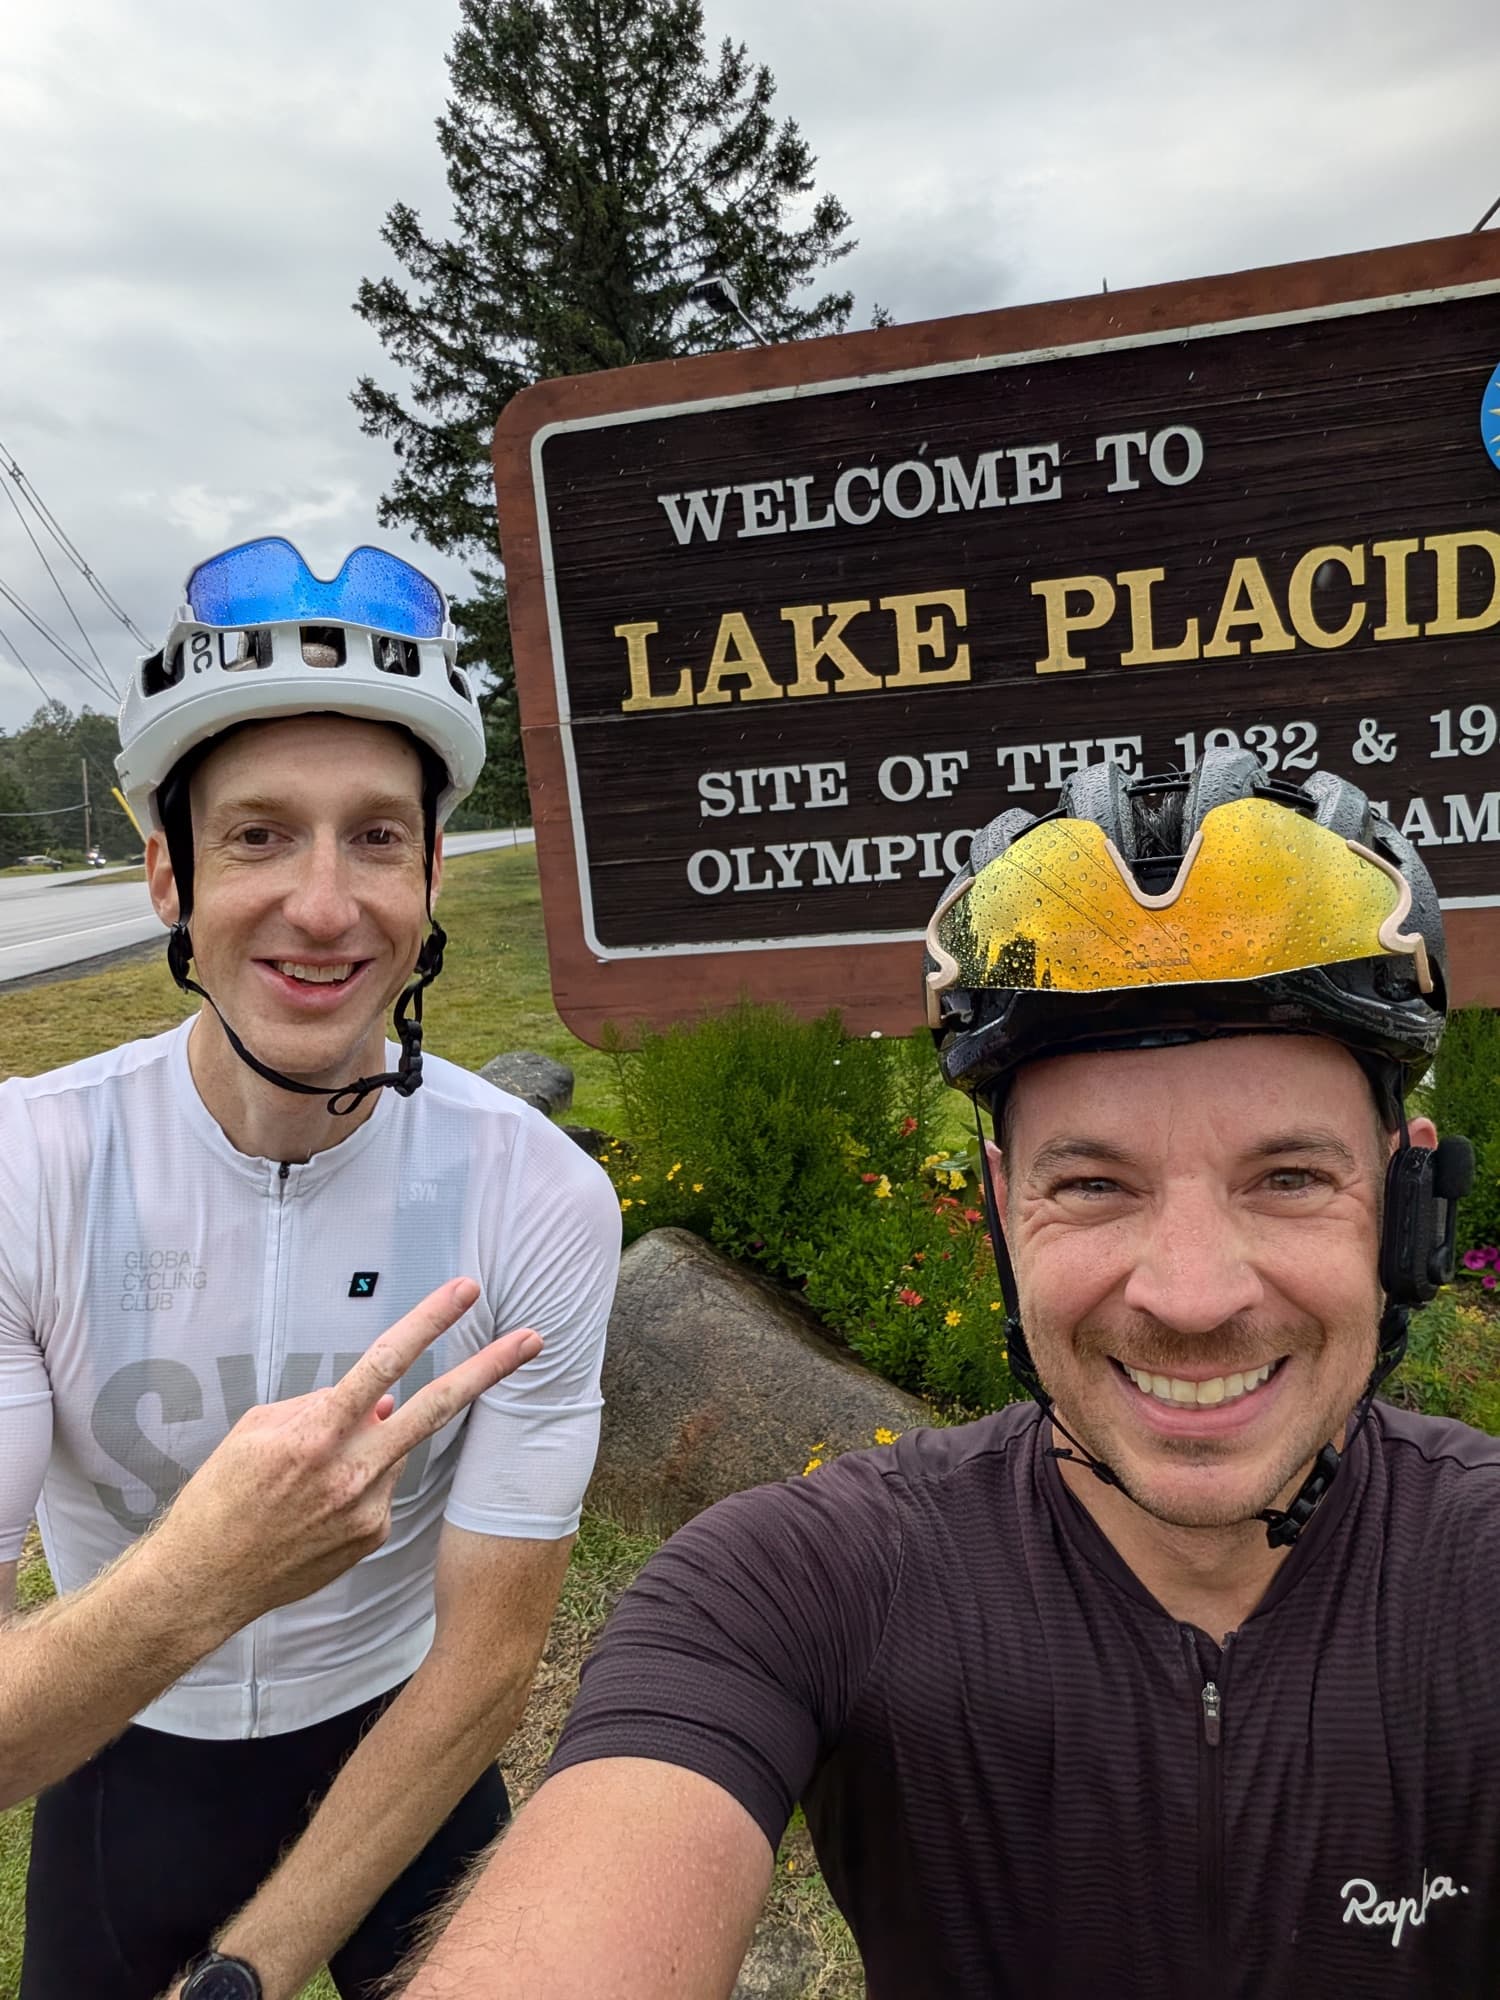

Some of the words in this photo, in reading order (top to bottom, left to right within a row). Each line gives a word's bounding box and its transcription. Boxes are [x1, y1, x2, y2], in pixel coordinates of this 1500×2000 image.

[657, 443, 1062, 545] WELCOME
[1096, 426, 1205, 493] TO
[614, 588, 972, 713] LAKE
[1030, 530, 1500, 675] PLACID
[698, 761, 849, 818] SITE
[878, 750, 969, 803] OF
[997, 735, 1144, 792] THE
[1352, 718, 1398, 765] &
[1430, 703, 1500, 759] 19
[1368, 791, 1500, 847] AM
[122, 1271, 208, 1291] CYCLING
[125, 1250, 204, 1270] GLOBAL
[120, 1292, 174, 1312] CLUB
